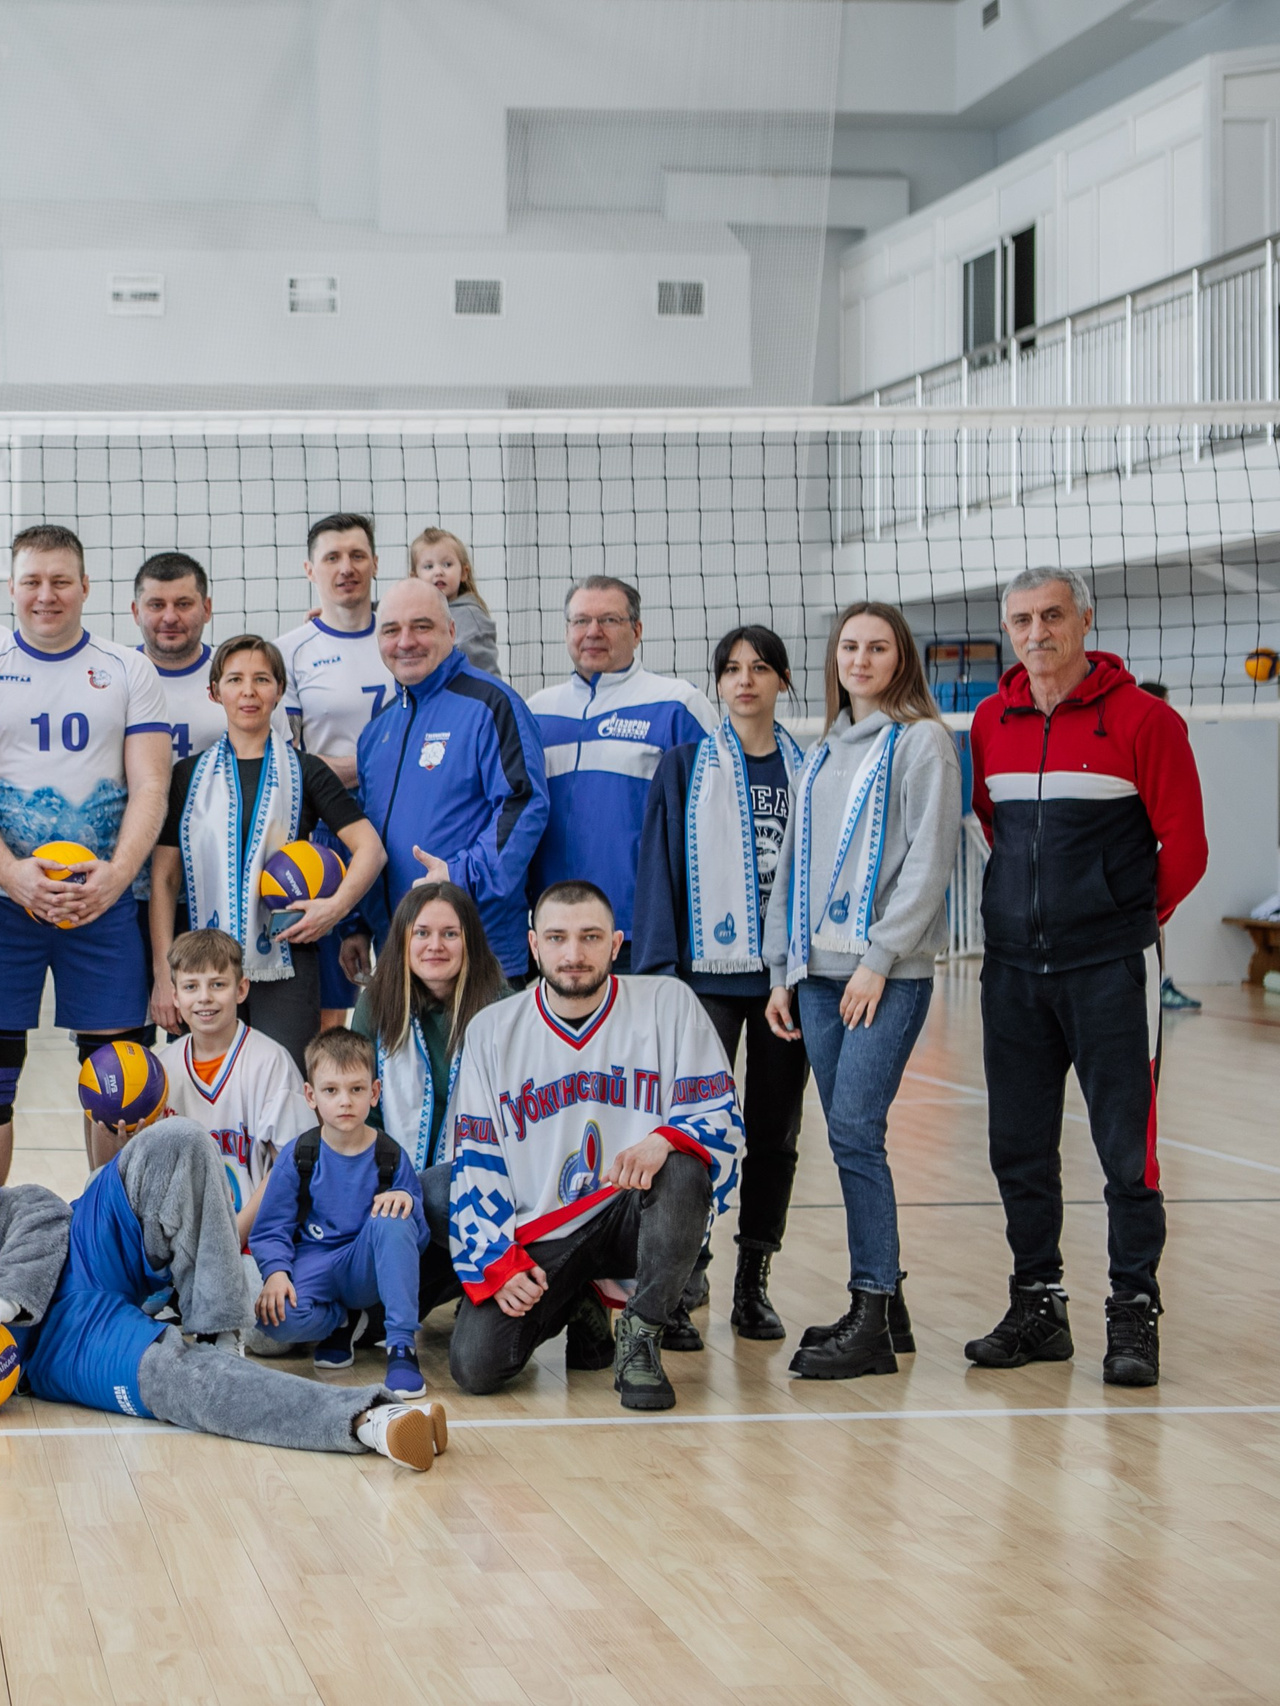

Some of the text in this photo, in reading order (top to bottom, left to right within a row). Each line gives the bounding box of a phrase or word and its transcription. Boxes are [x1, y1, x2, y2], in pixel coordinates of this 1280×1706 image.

[361, 684, 387, 721] 7
[30, 712, 90, 752] 10
[171, 723, 194, 758] 4
[499, 1064, 627, 1142] Губкинский
